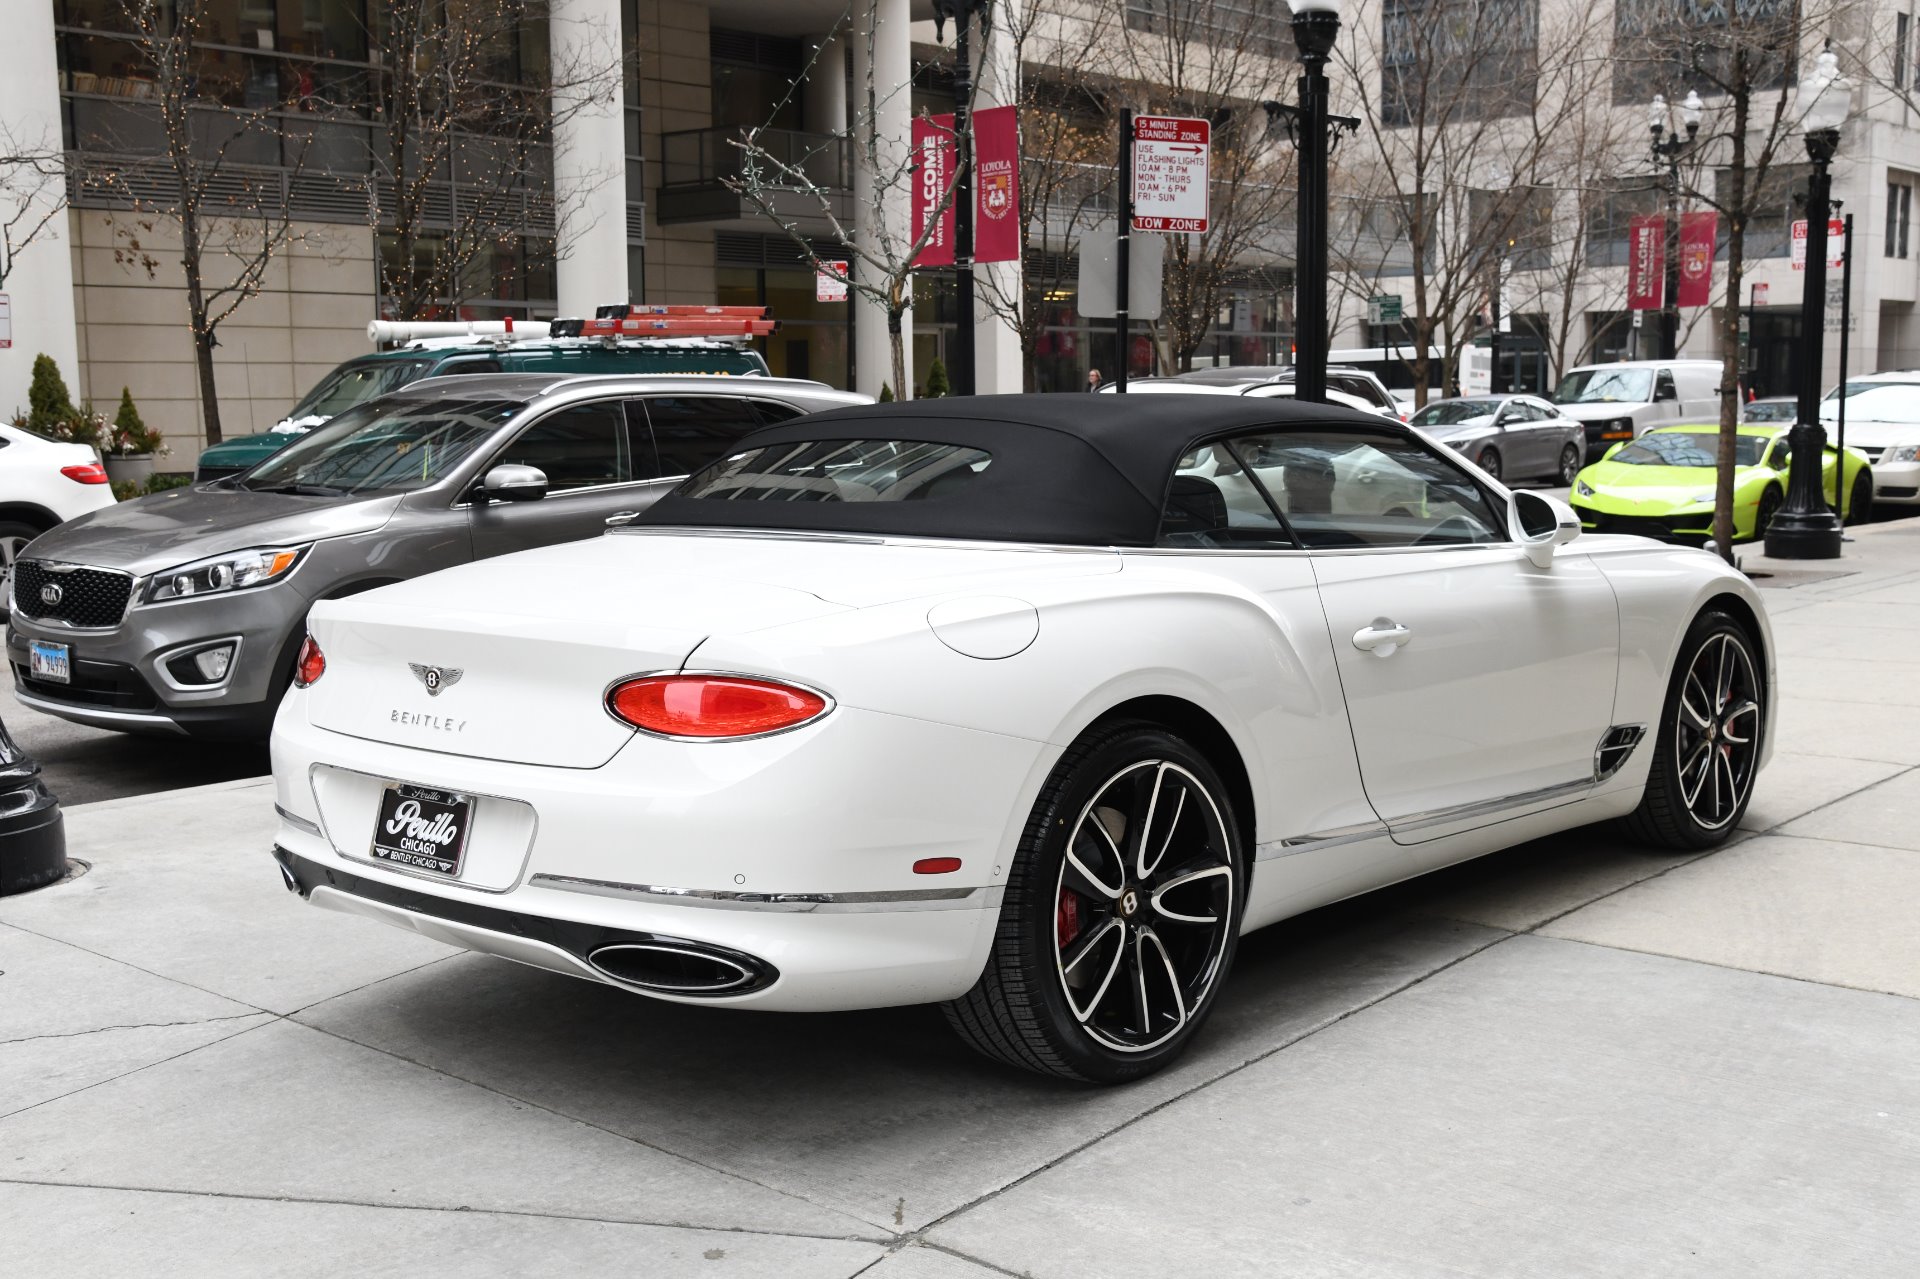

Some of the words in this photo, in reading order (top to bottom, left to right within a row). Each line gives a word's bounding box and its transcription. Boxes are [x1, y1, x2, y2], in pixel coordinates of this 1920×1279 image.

[1139, 119, 1147, 129] 15
[1149, 121, 1178, 131] MINUTE
[1139, 130, 1177, 141] STANDING
[1181, 132, 1201, 141] ZONE
[1138, 144, 1154, 153] USE
[1138, 154, 1176, 165] FLASHING
[1178, 156, 1205, 166] LIGHTS
[981, 160, 1012, 173] LOYOLA
[1138, 164, 1146, 172] 10
[1148, 164, 1160, 173] AM
[1168, 165, 1173, 173] 8
[1176, 165, 1188, 174] PM
[1138, 173, 1156, 182] MON
[1164, 174, 1191, 184] THURS
[1167, 184, 1173, 192] 6
[1174, 184, 1187, 193] PM
[1137, 193, 1151, 201] FRI
[1158, 193, 1175, 202] SUN
[1138, 217, 1163, 229] TOW
[1169, 219, 1201, 231] ZONE
[42, 587, 58, 601] KIA
[46, 654, 67, 676] 94999
[391, 709, 467, 732] BENTLEY
[411, 789, 441, 801] Perillo
[386, 800, 457, 846] Perillo
[400, 837, 436, 856] CHICAGO
[390, 850, 412, 863] BENTLEY
[412, 856, 437, 869] CHICAGO
